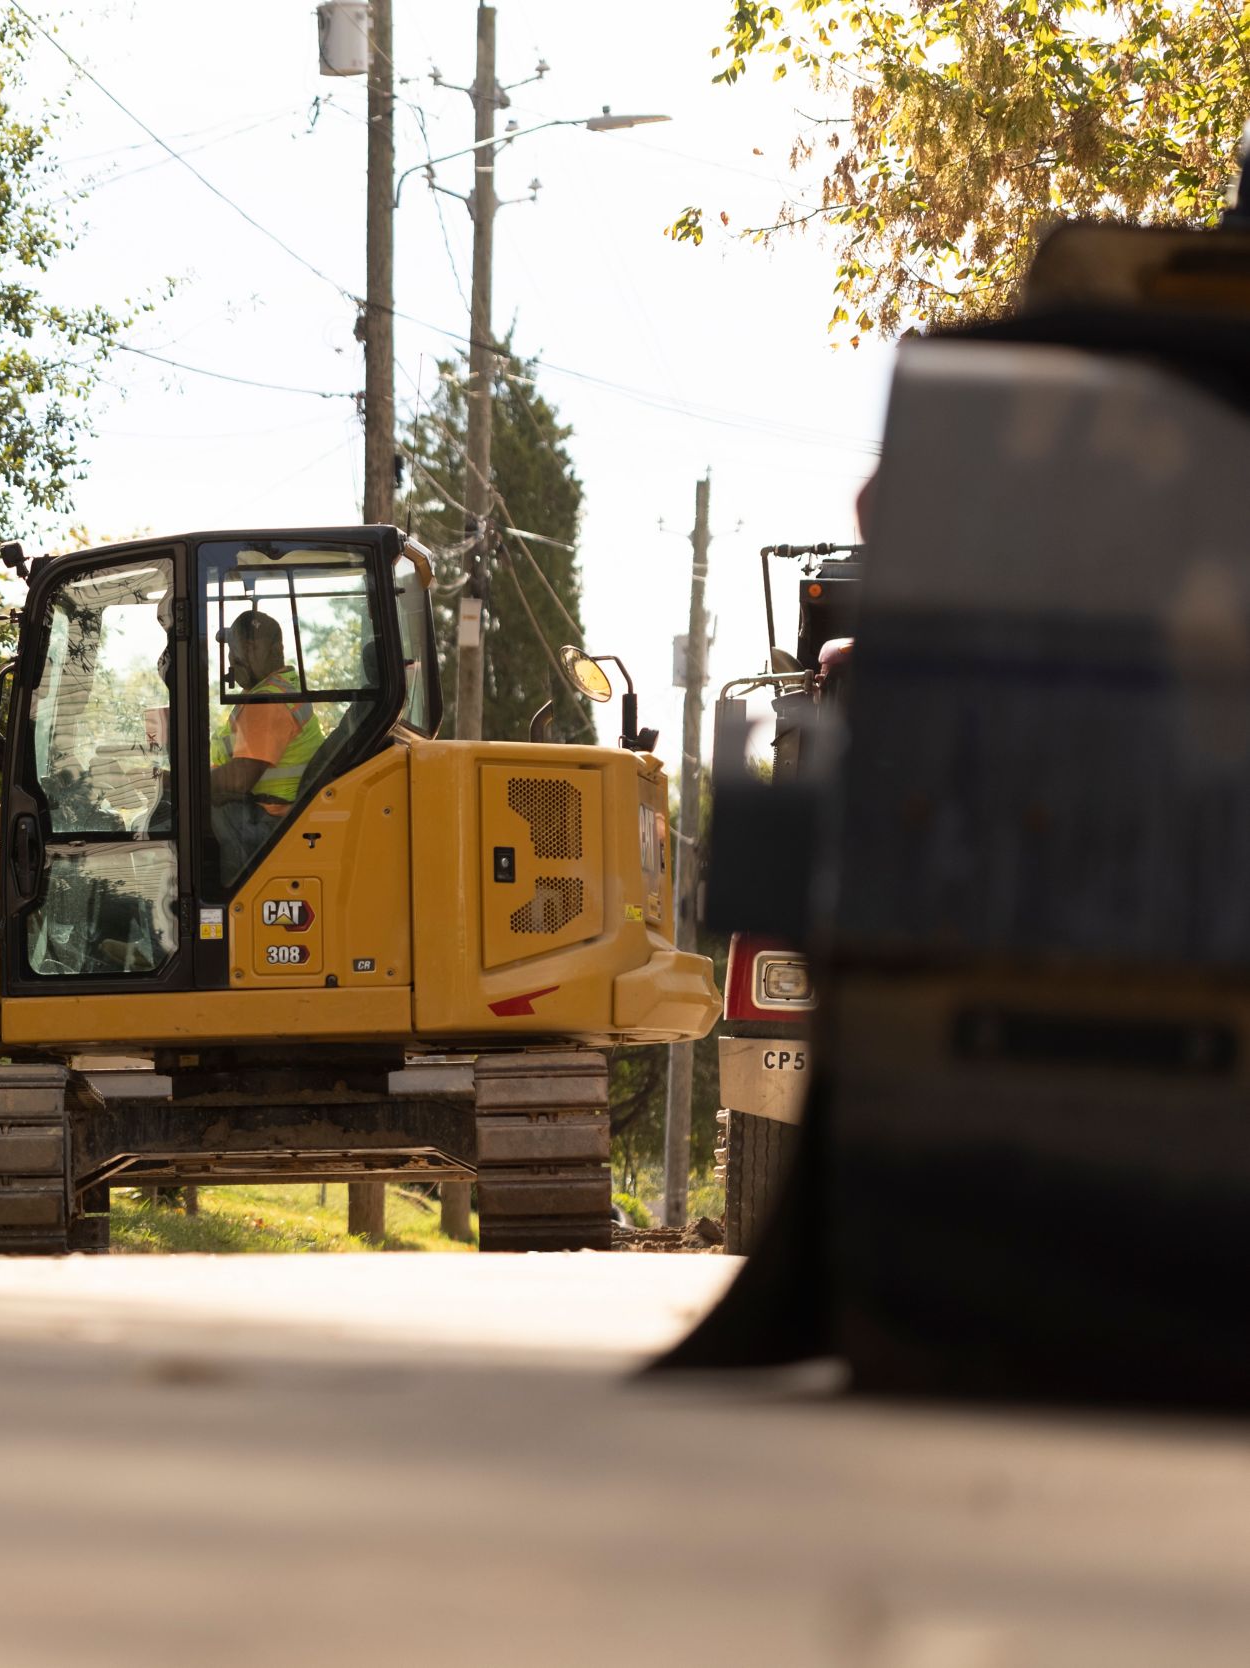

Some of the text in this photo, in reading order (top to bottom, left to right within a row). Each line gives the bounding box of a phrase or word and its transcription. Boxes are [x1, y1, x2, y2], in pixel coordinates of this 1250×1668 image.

[639, 804, 654, 868] CAT
[263, 901, 302, 925] CAT
[267, 946, 300, 963] 308
[357, 961, 371, 970] CR
[764, 1051, 805, 1070] CP5
